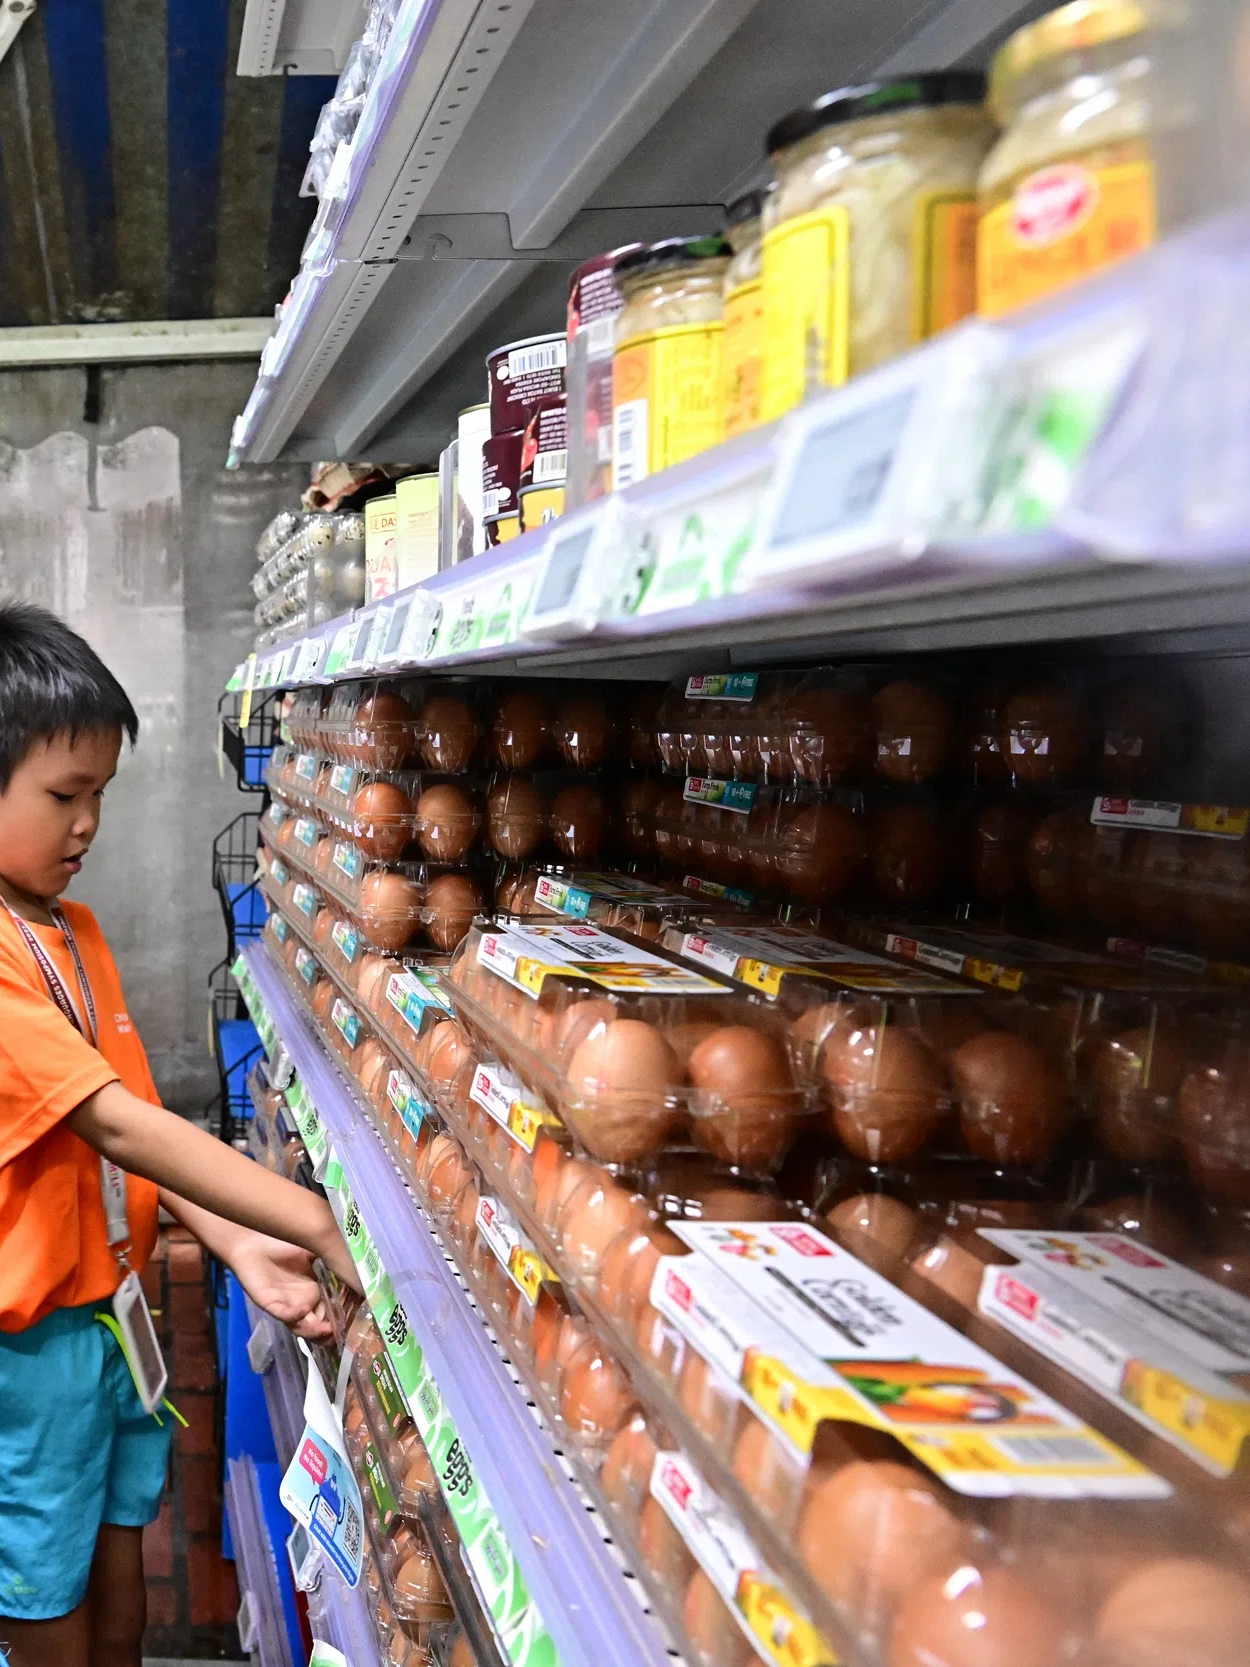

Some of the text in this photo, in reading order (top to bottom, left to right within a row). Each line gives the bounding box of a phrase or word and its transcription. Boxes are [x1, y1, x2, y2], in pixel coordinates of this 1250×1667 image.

[30, 942, 56, 985] SYMPOSIUM
[384, 1302, 408, 1346] eggs
[442, 1437, 473, 1497] eggs
